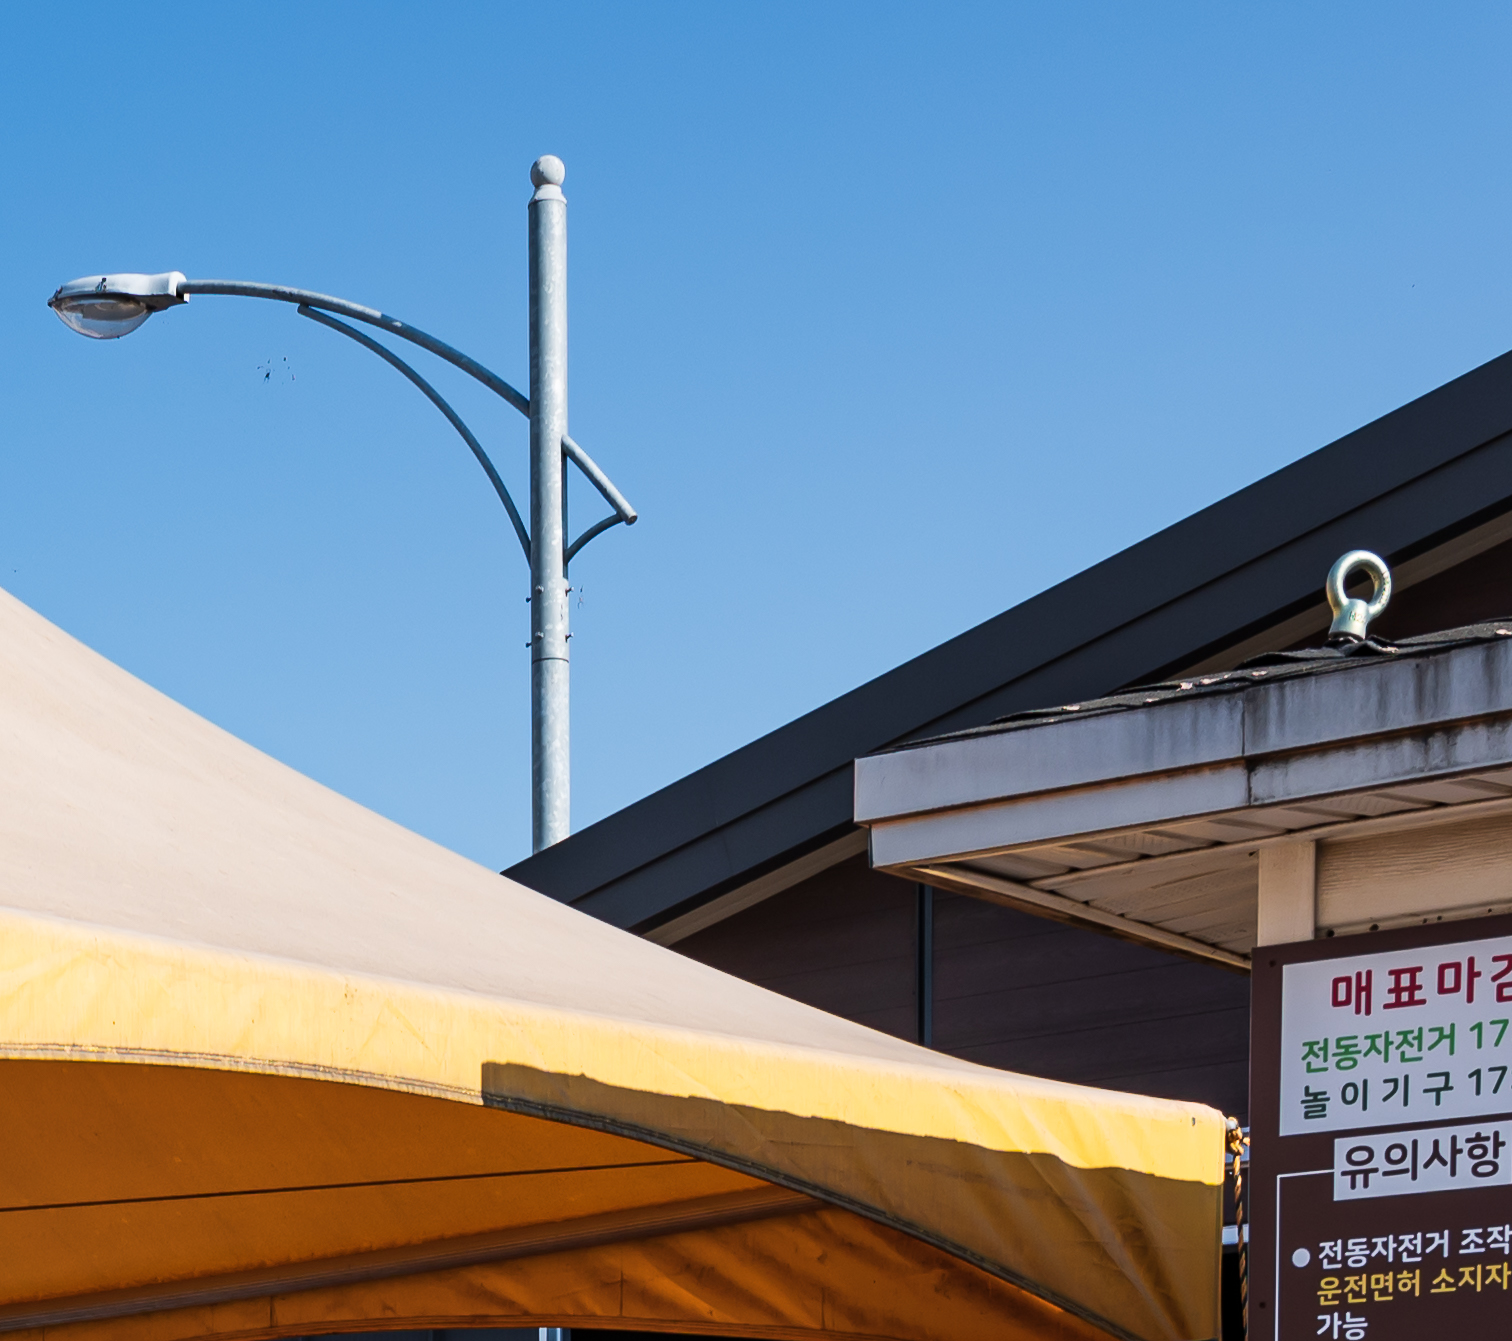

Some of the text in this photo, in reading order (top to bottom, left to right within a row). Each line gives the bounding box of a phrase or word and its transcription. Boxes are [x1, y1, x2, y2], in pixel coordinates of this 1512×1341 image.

[1301, 1022, 1456, 1073] 전동자전거
[1301, 1070, 1454, 1120] 놀이기구
[1341, 1130, 1506, 1190] 유의사항
[1318, 1229, 1450, 1269] 전동자전거
[1317, 1269, 1420, 1306] 운전면허
[1317, 1311, 1368, 1341] 가능
